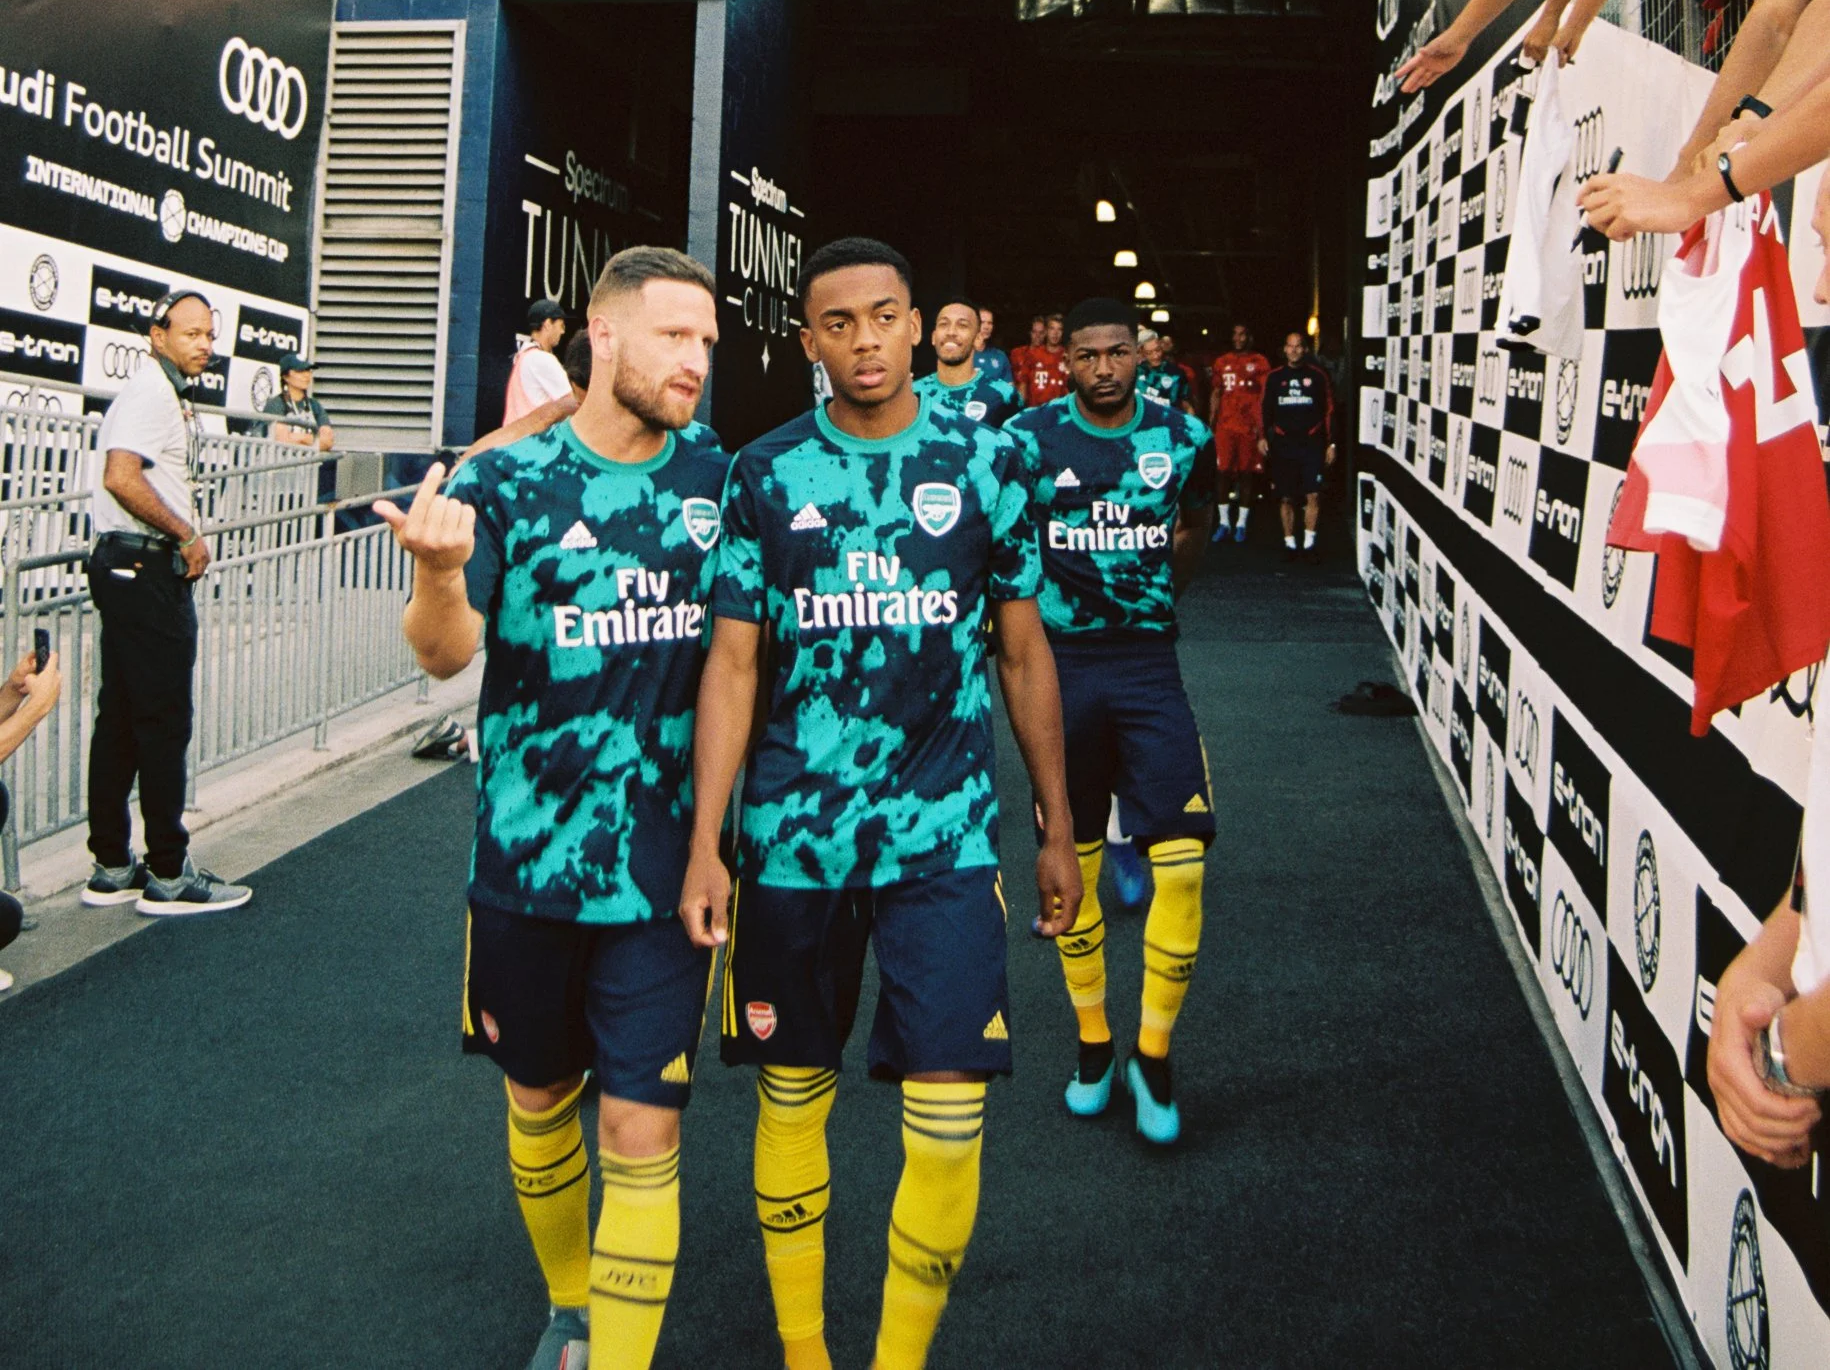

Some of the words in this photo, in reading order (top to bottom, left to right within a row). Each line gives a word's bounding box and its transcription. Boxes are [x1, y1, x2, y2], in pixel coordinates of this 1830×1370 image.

[0, 66, 55, 119] udi
[64, 81, 190, 172] Football
[195, 137, 293, 212] Summit
[26, 154, 158, 221] INTERNATIONAL
[187, 211, 268, 257] CHAMPIONS
[267, 236, 289, 263] CUP
[751, 166, 787, 214] Spectrum
[95, 286, 155, 319] e-tro
[743, 286, 788, 338] CLUB
[240, 322, 299, 352] e-tron
[1092, 500, 1130, 524] Fly
[1048, 521, 1168, 550] Emirates
[616, 567, 669, 602] Fly
[846, 552, 900, 587] Fly
[553, 599, 706, 648] Emirate
[794, 582, 958, 629] Emirates
